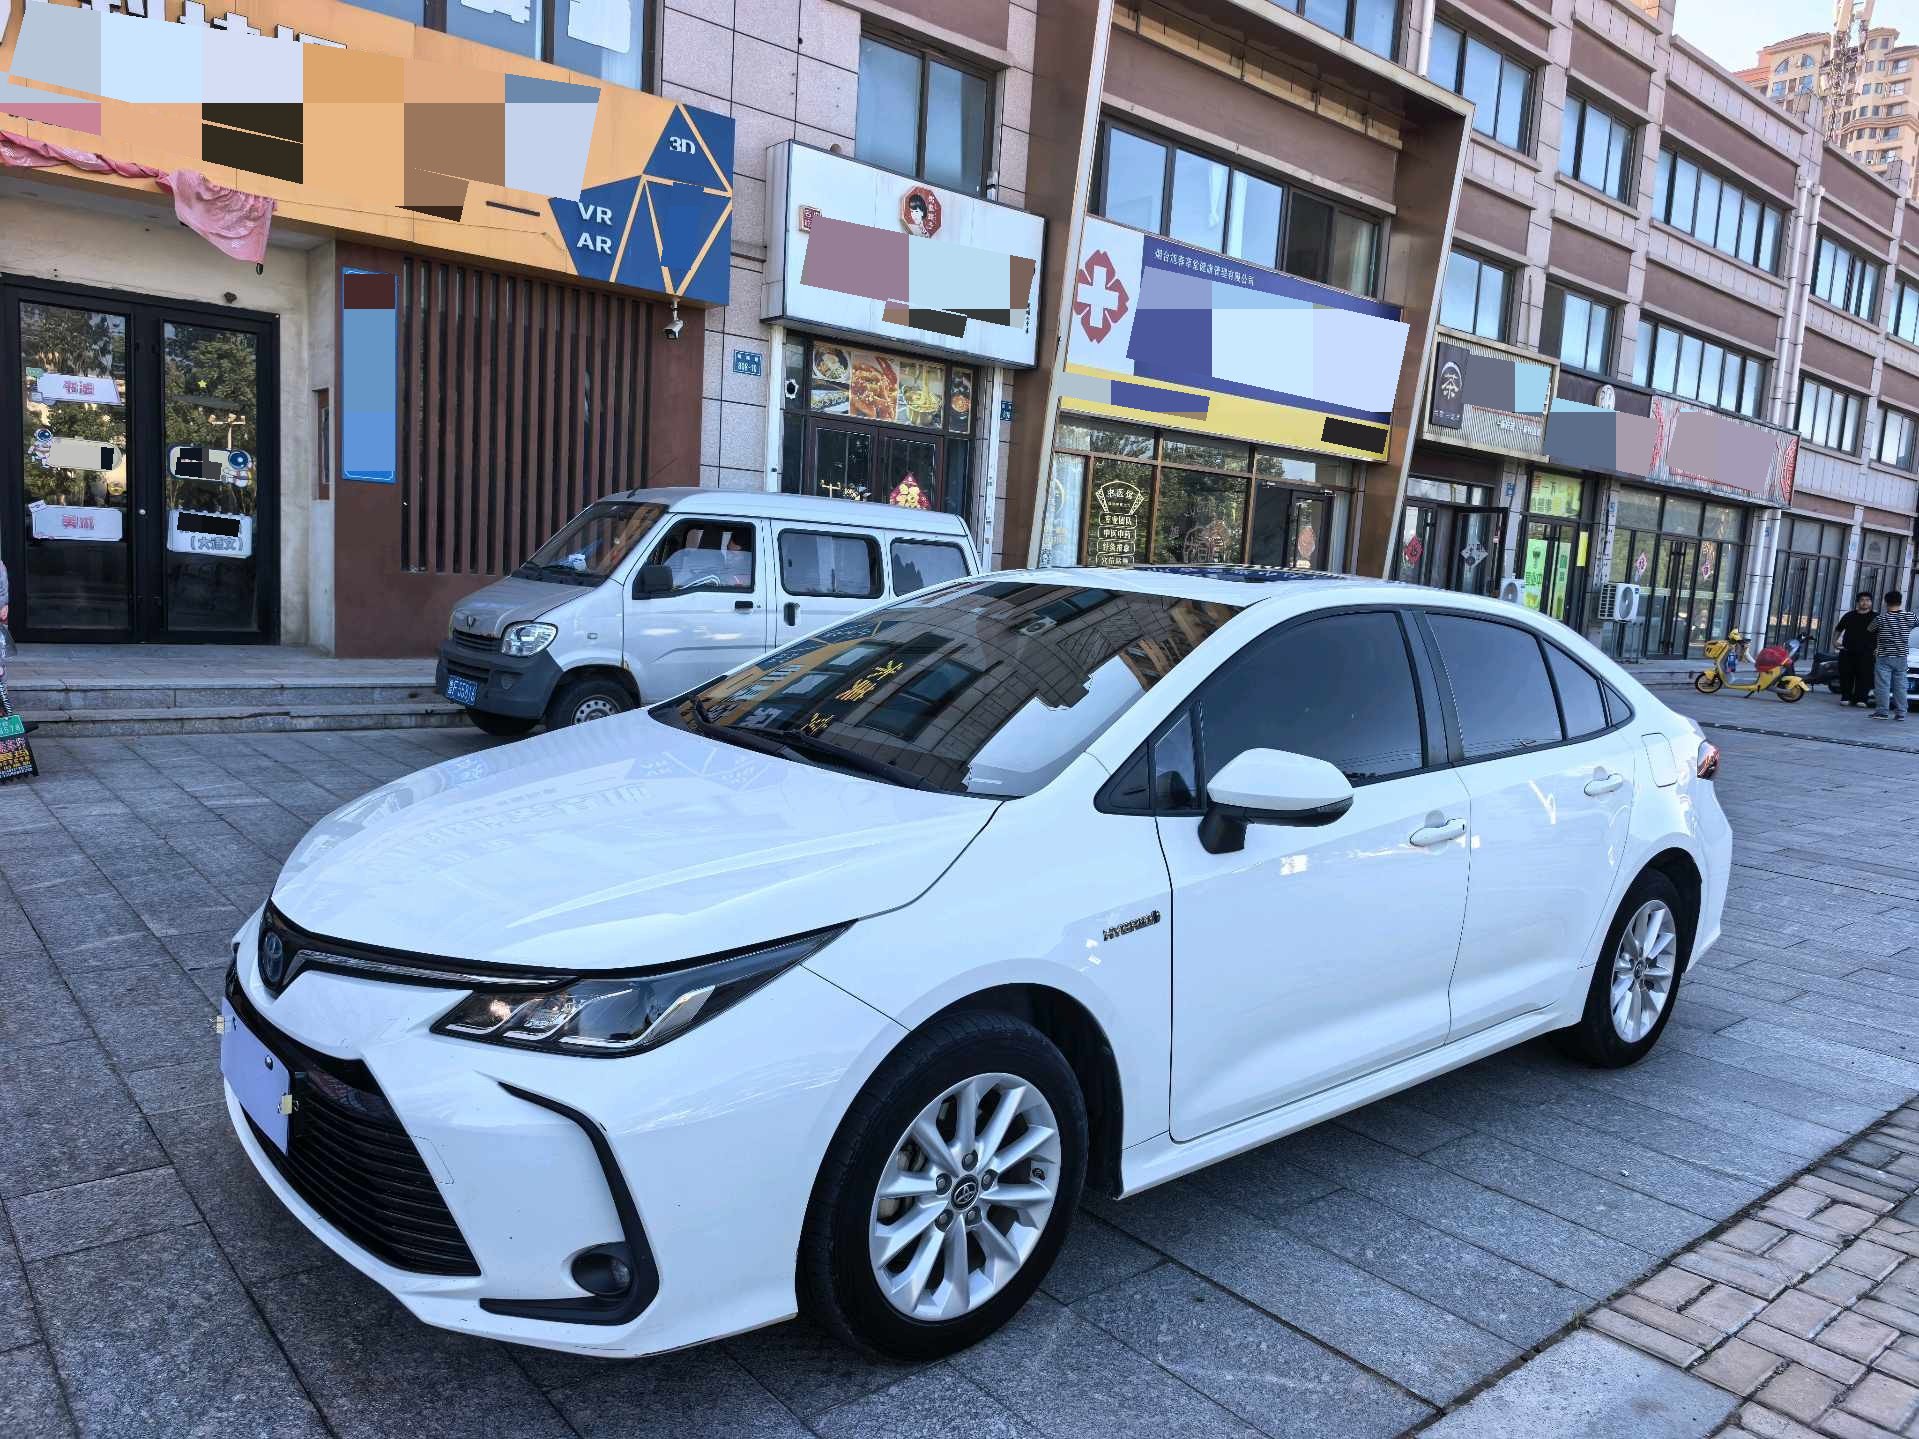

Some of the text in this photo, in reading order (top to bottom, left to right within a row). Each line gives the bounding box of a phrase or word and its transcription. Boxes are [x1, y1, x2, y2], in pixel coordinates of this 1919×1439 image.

[669, 136, 696, 155] 3D
[577, 201, 613, 226] VR
[576, 232, 612, 254] AR
[1441, 373, 1460, 400] 茶
